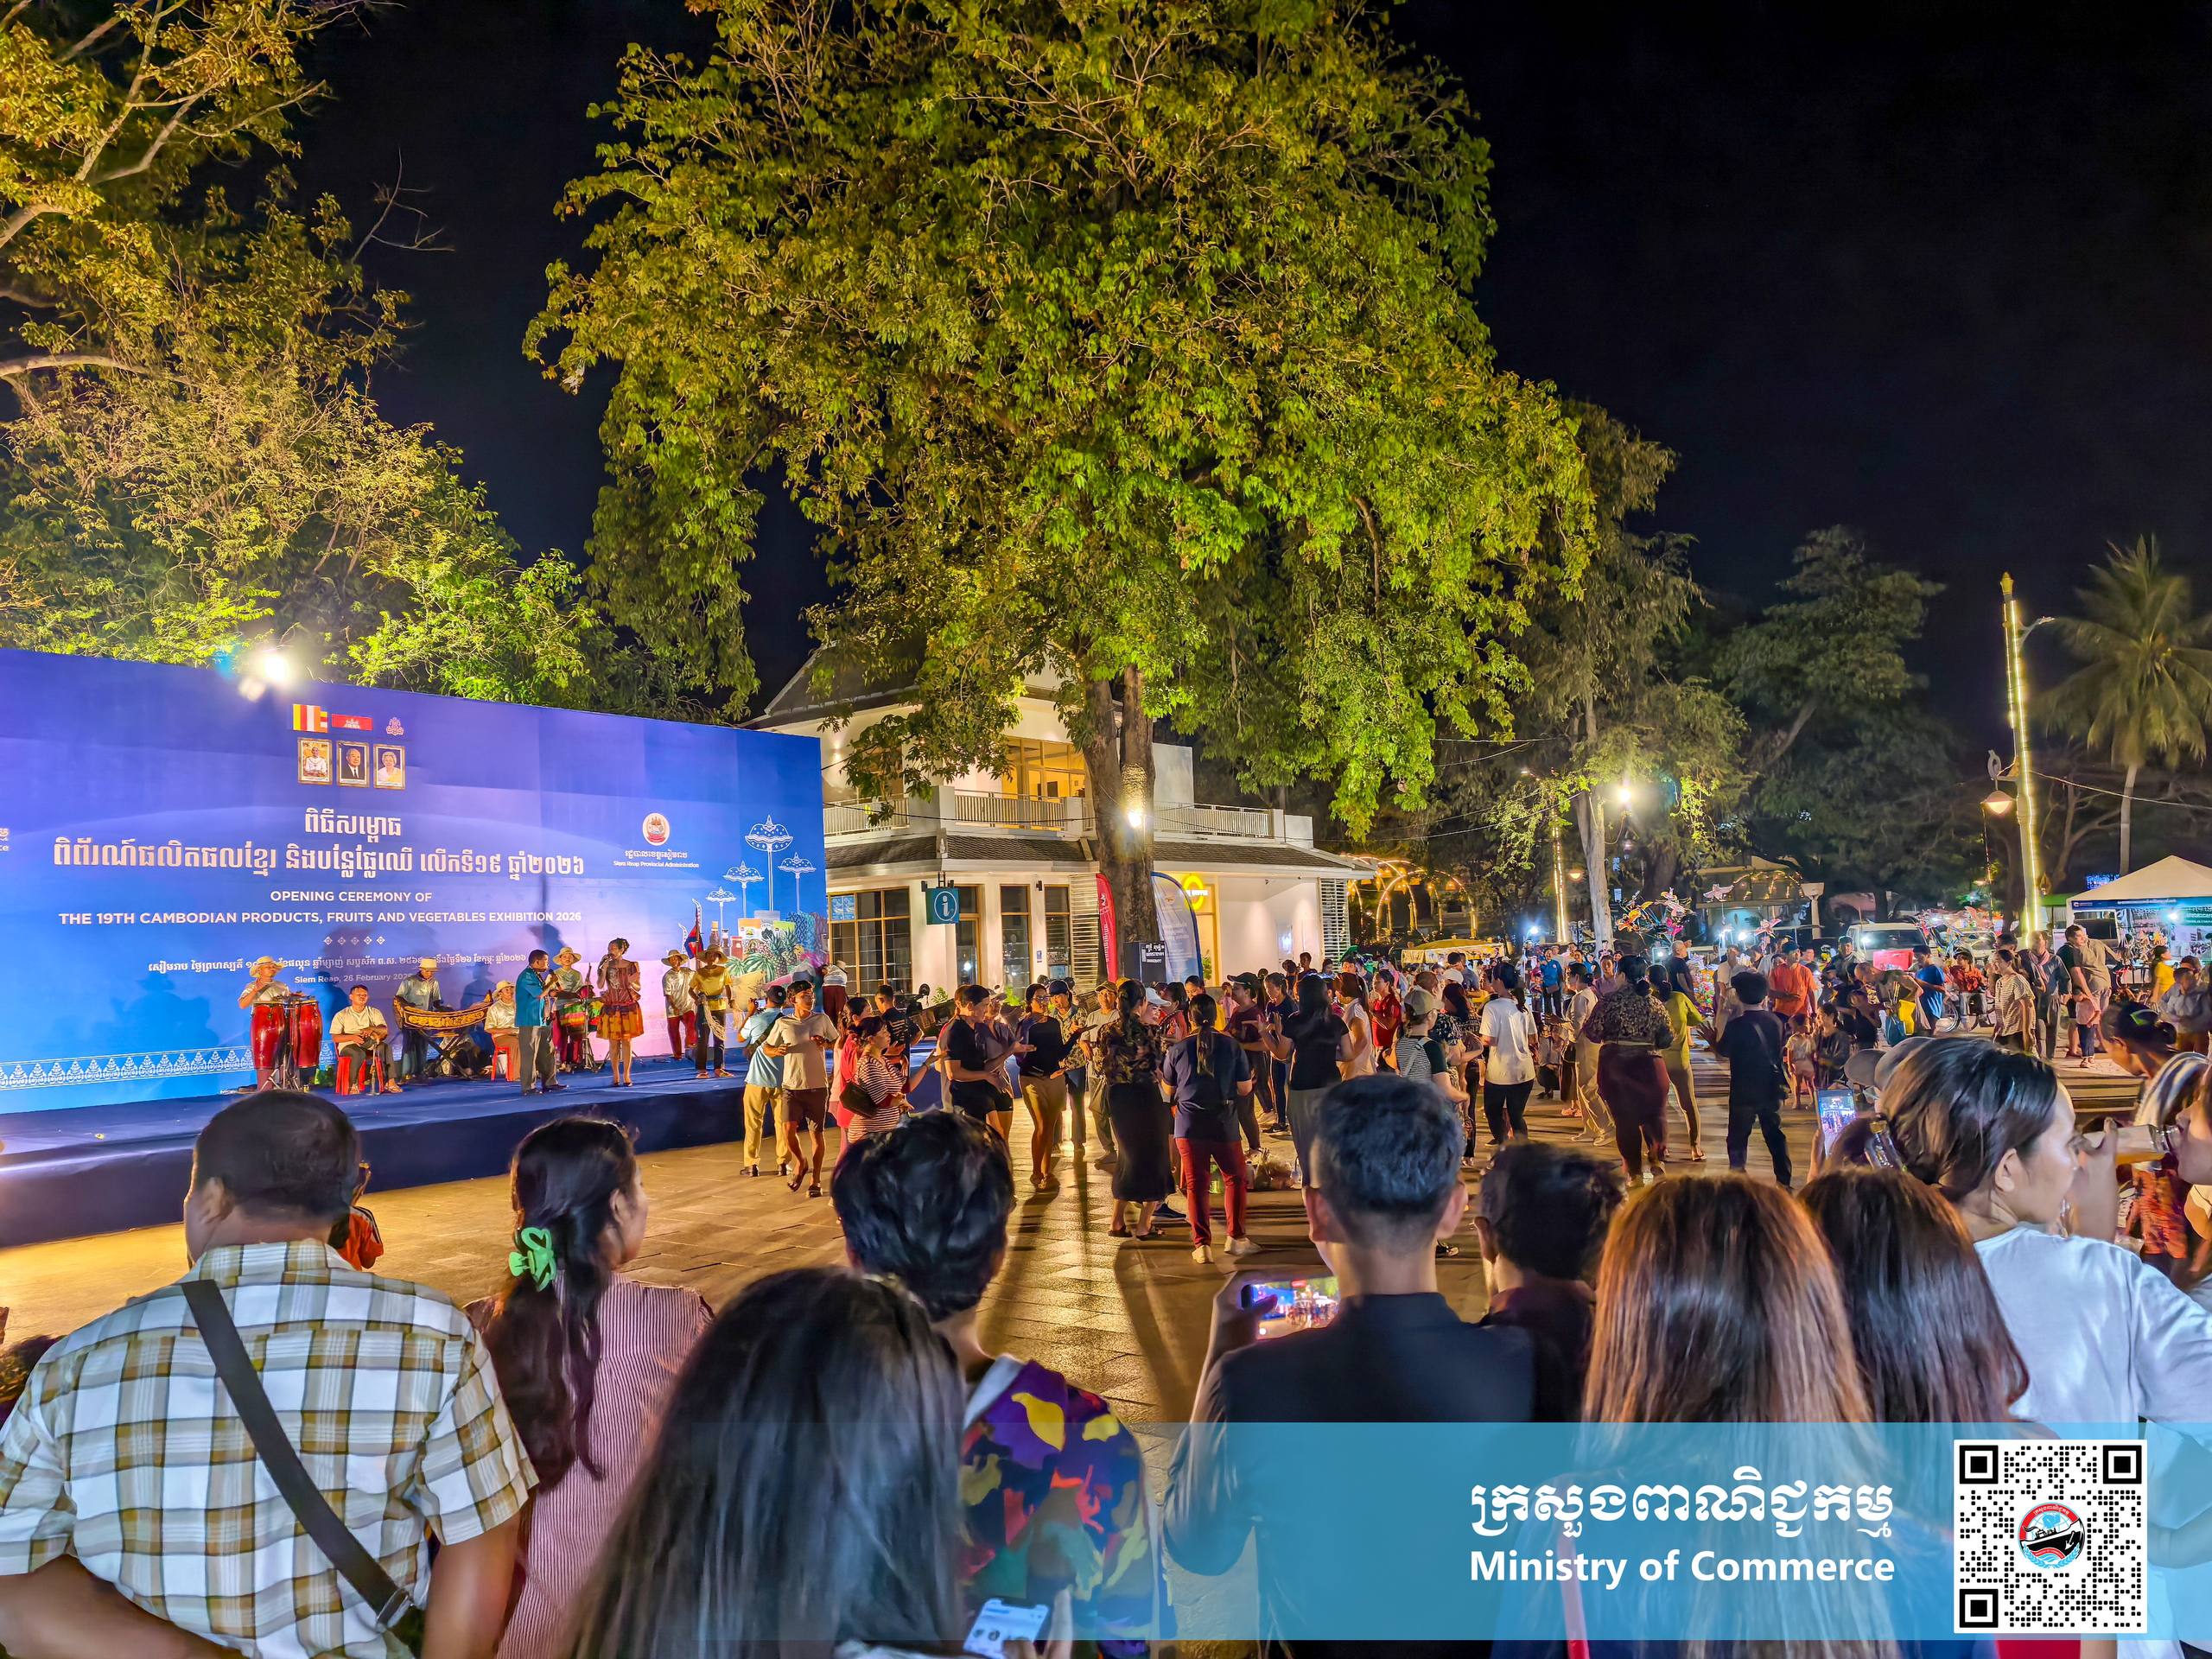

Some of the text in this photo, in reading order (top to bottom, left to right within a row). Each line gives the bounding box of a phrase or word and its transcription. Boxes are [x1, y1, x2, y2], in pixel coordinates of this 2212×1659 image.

[304, 807, 402, 843] ពិធីសម្ពោធ
[54, 836, 584, 880] ពិព័រណ៍ផលិតផលខ្មែរ និងបន្លែផ្លែឈើ លើកទី១៩ ឆ្នាំ២០២៦
[270, 891, 433, 902] OPENING CEREMONY OF
[59, 912, 582, 925] THE 19TH CAMBODIAN PRODUCTS, FRUITS AND VEGETABLES EXHIBITION 2026
[294, 976, 316, 984] Siem
[317, 976, 341, 984] Reap,
[356, 974, 391, 982] February
